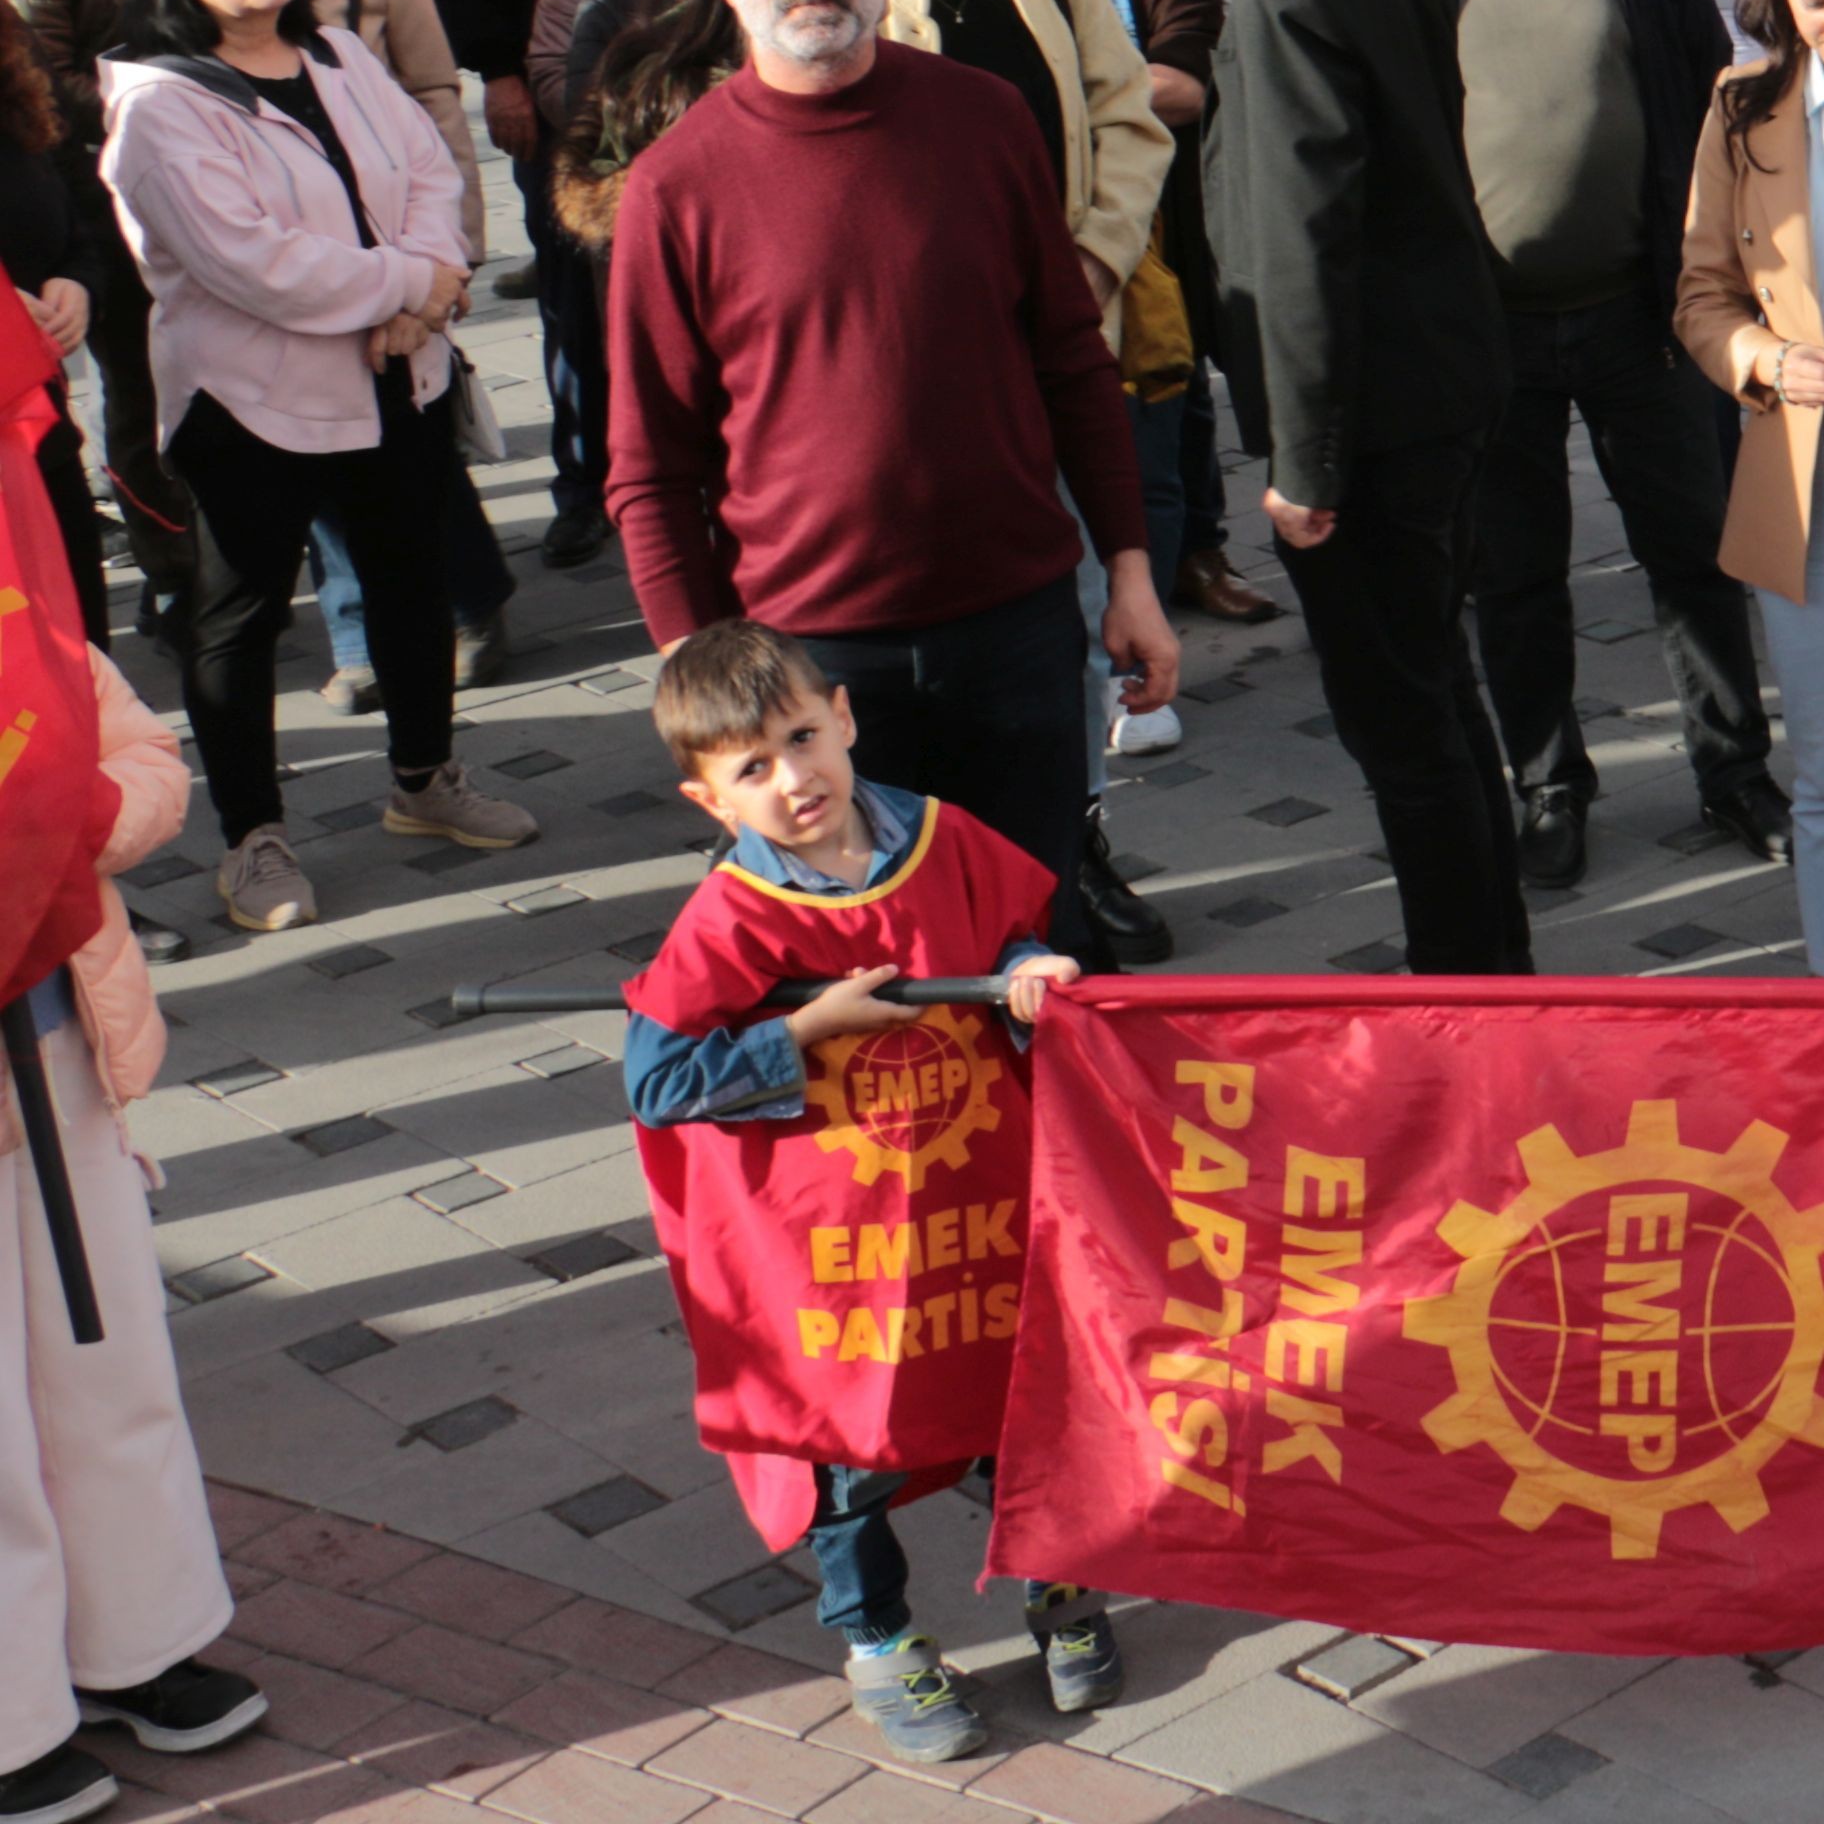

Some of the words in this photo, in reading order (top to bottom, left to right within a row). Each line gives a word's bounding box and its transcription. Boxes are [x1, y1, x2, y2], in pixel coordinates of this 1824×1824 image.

[851, 1054, 973, 1116] EMEP
[797, 1275, 1020, 1367] PARTİS
[810, 1196, 1019, 1286] EMEK
[1139, 1058, 1261, 1518] PARTİSİ
[1260, 1142, 1368, 1488] EMEK
[1596, 1190, 1691, 1478] EMEP
